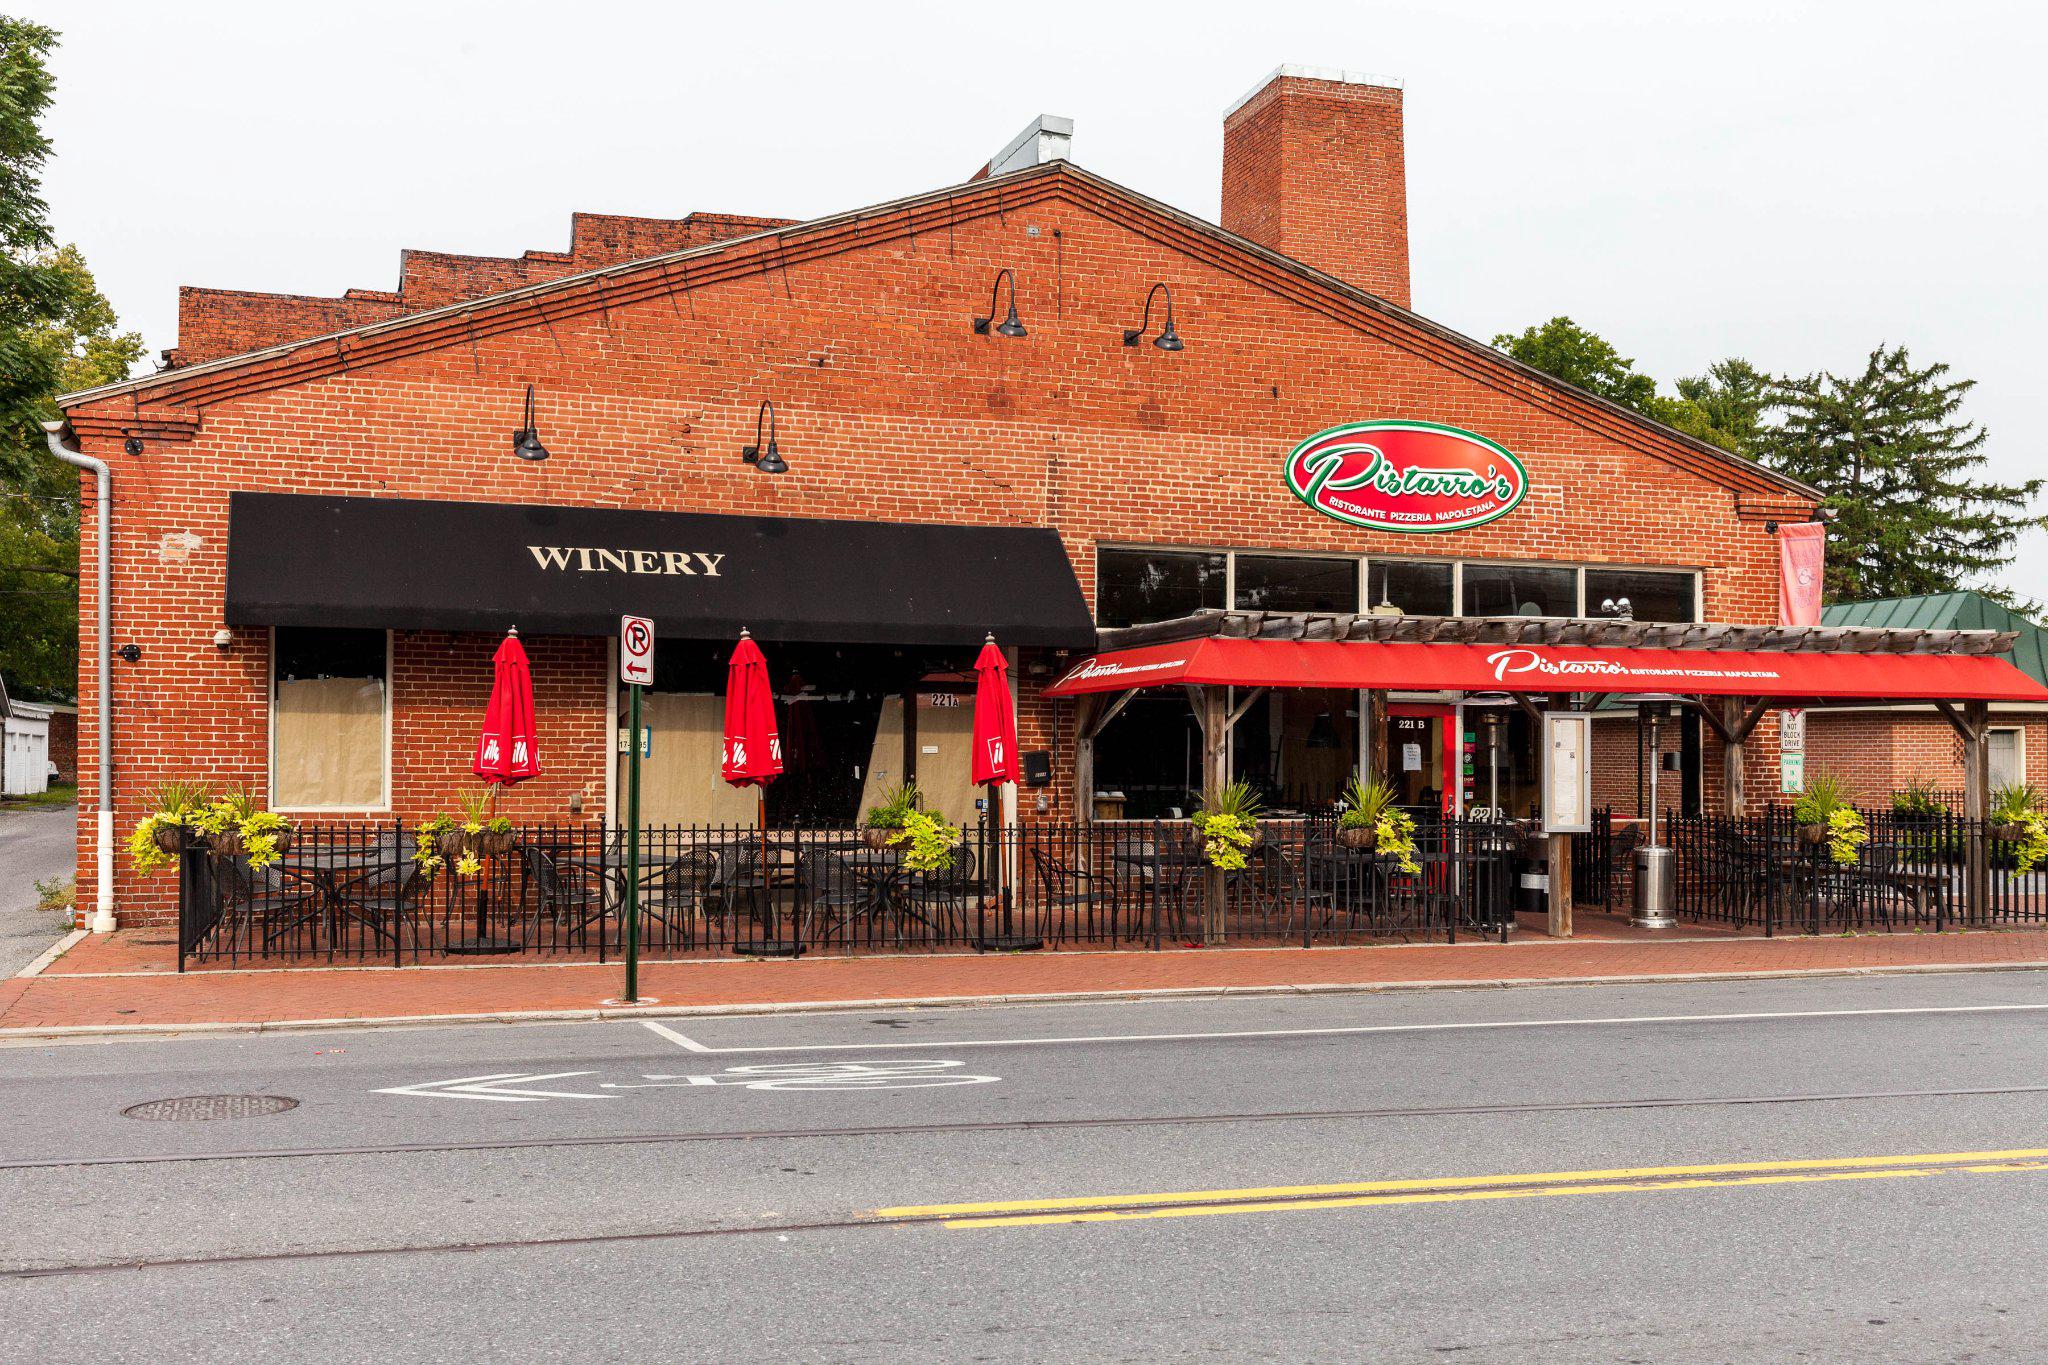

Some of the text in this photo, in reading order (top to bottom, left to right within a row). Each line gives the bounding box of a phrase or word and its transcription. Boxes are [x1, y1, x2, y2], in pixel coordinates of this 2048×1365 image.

[1303, 442, 1513, 506] Pistarro's
[1329, 496, 1496, 522] RISTORANTE PIZZERIA NAPOLETANA
[527, 546, 726, 577] WINERY
[1487, 650, 1629, 682] Pistarro's
[1630, 668, 1684, 676] RISTORANTE
[1685, 669, 1724, 678] PIZZERIA
[1398, 719, 1425, 729] 221 B
[1783, 731, 1801, 739] BLOCK
[1784, 739, 1800, 747] DRIVE
[1783, 758, 1801, 766] PARKING
